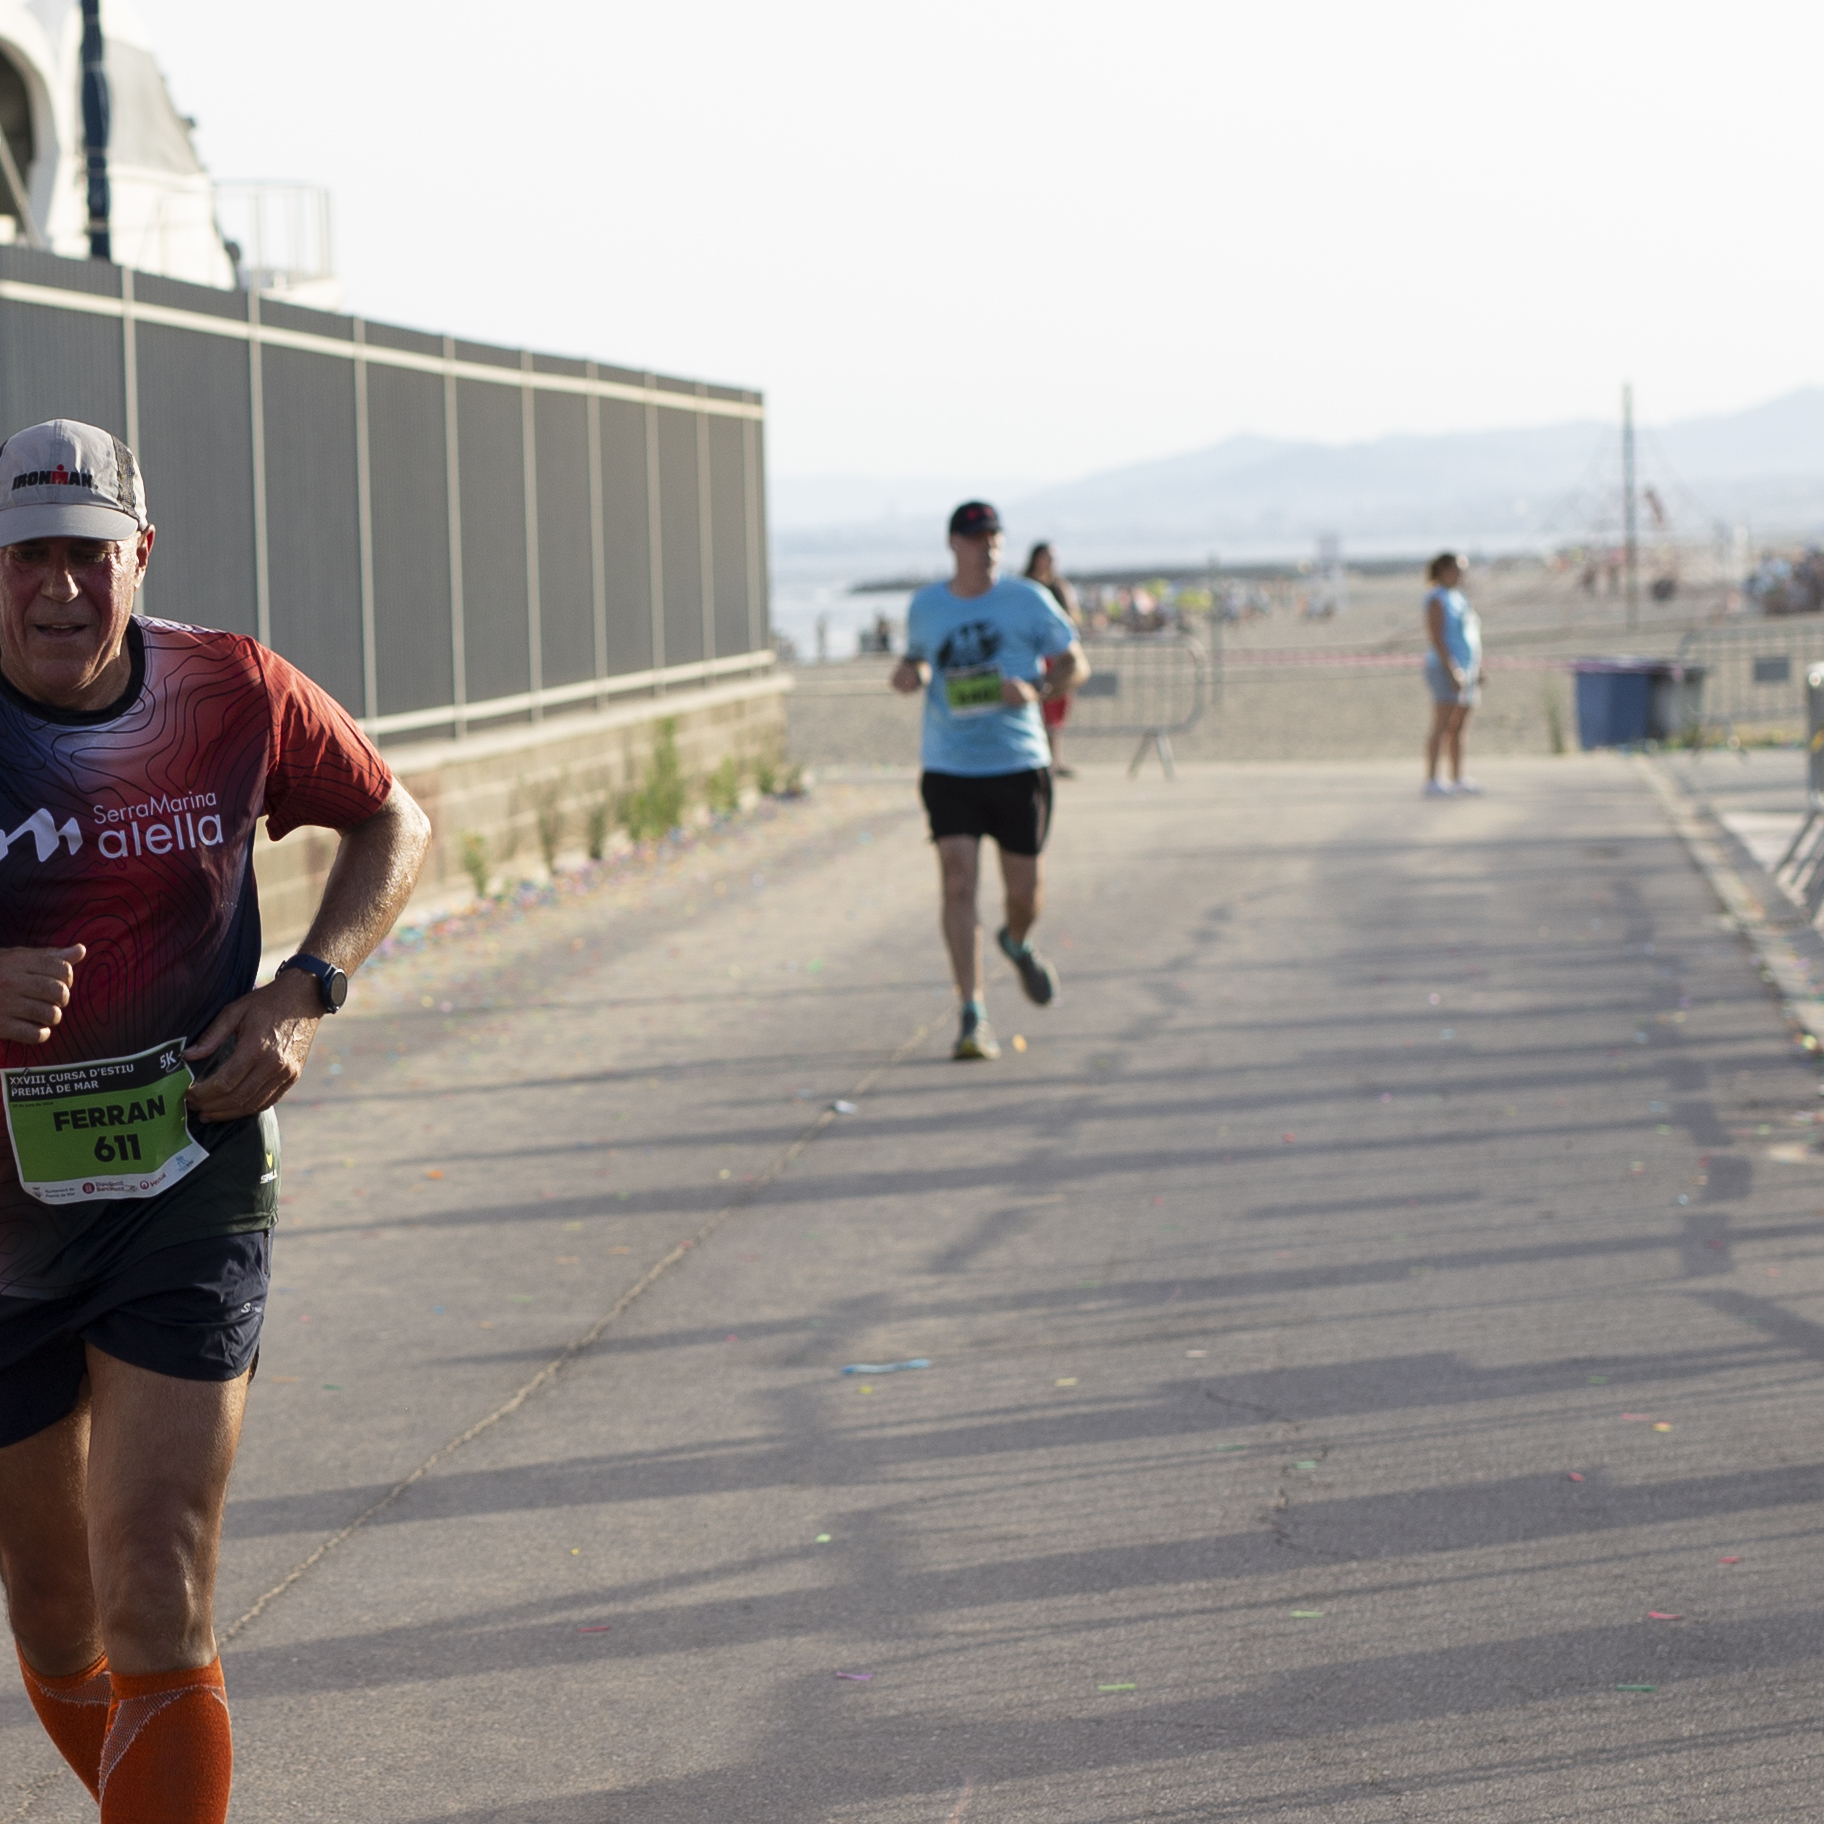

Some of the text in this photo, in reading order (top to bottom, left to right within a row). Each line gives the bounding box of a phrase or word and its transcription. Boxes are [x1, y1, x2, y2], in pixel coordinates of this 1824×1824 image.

[12, 464, 93, 491] IRONMAN
[93, 791, 217, 824] SerraMarina
[98, 813, 224, 859] alella
[159, 1050, 176, 1069] 5K
[9, 1074, 46, 1086] XXVIII
[49, 1072, 87, 1083] CURSA
[11, 1080, 99, 1097] PREMIÀ DE MAR
[52, 1095, 166, 1132] FERRAN
[94, 1133, 142, 1163] 611
